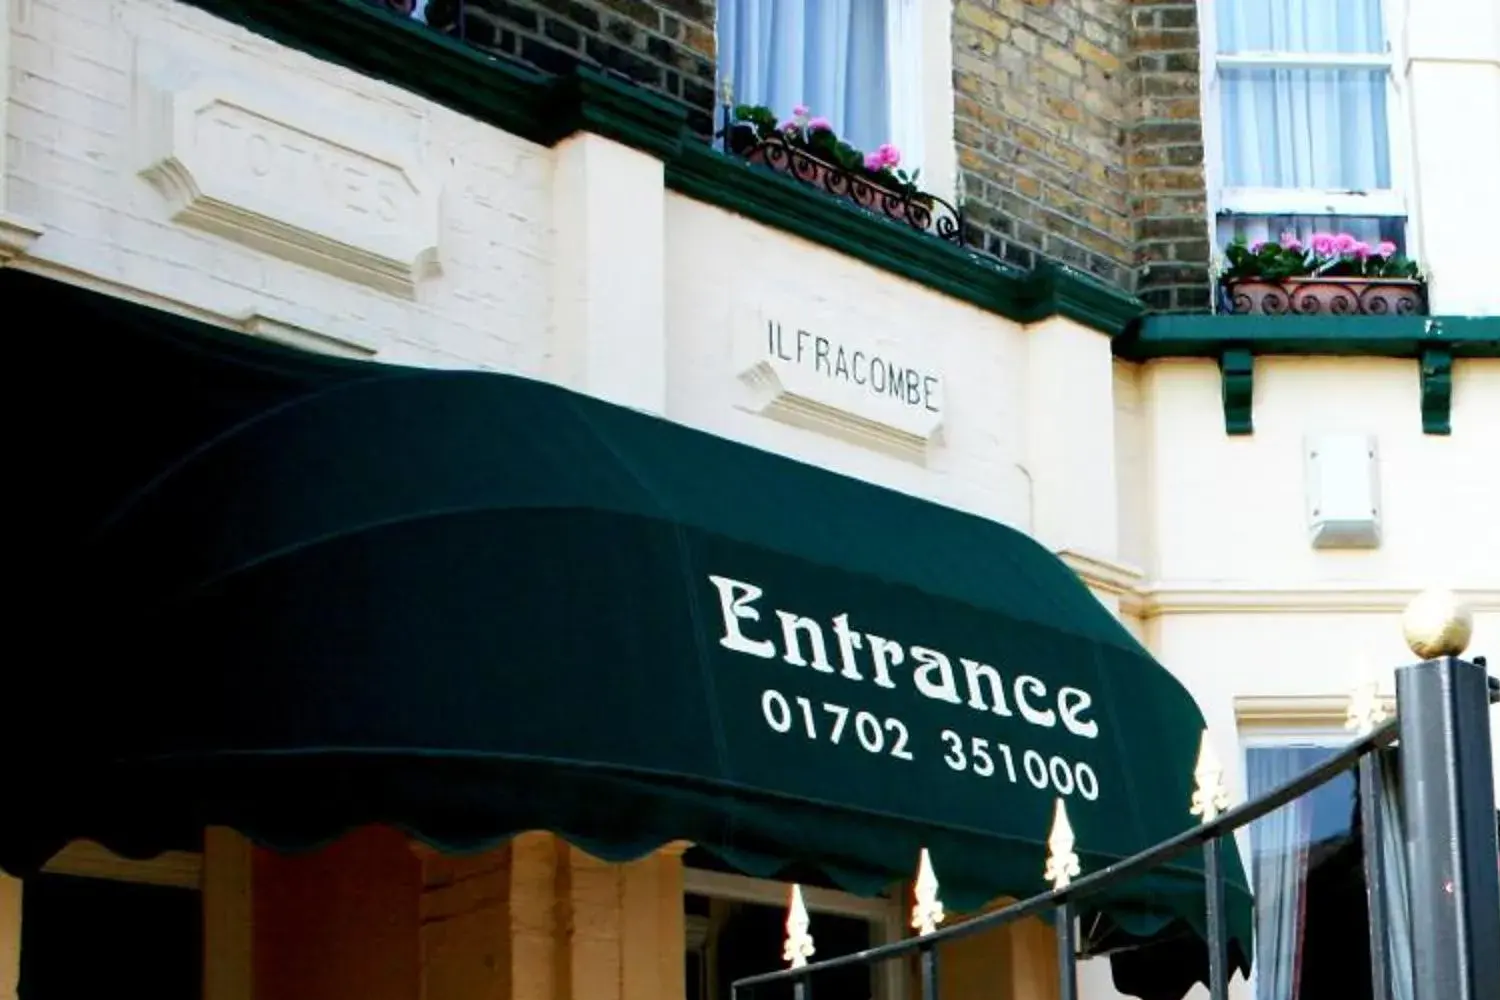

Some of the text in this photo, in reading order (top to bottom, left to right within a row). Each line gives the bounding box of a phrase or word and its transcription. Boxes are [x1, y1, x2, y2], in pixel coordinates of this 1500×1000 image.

[767, 319, 940, 413] ILFRACOMBE
[709, 574, 1099, 739] Entrance
[762, 689, 1099, 801] 01702 351000
